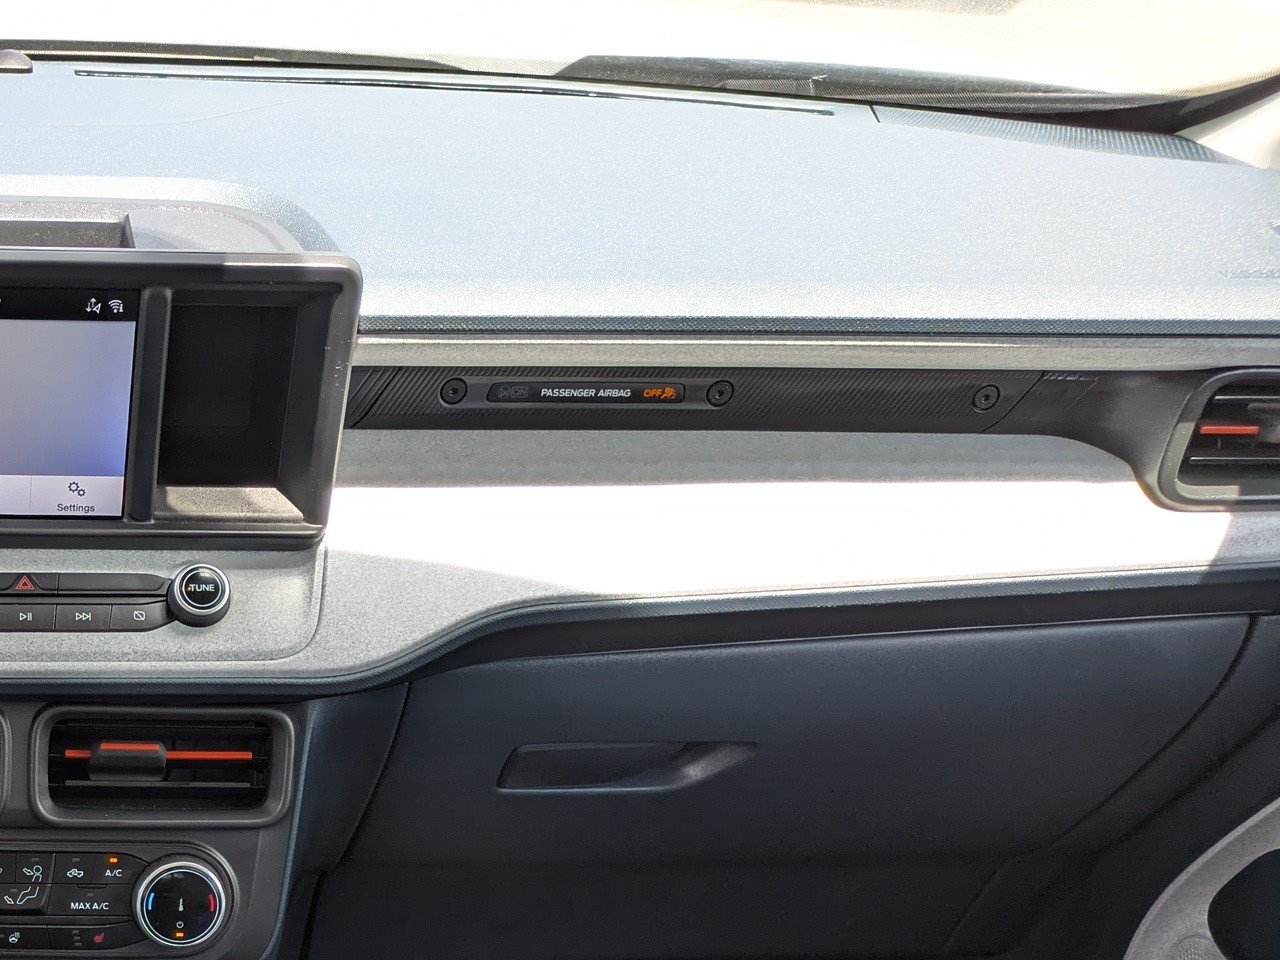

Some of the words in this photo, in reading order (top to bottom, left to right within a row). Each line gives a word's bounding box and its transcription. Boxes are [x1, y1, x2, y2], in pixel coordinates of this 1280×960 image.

[540, 388, 596, 397] PASSENGER
[597, 388, 631, 397] AIRBAG
[643, 389, 662, 398] OFF
[56, 503, 95, 514] Settings
[189, 584, 216, 592] TUNE
[105, 869, 122, 877] A/C
[70, 902, 91, 910] MAX
[92, 902, 109, 910] A/C
